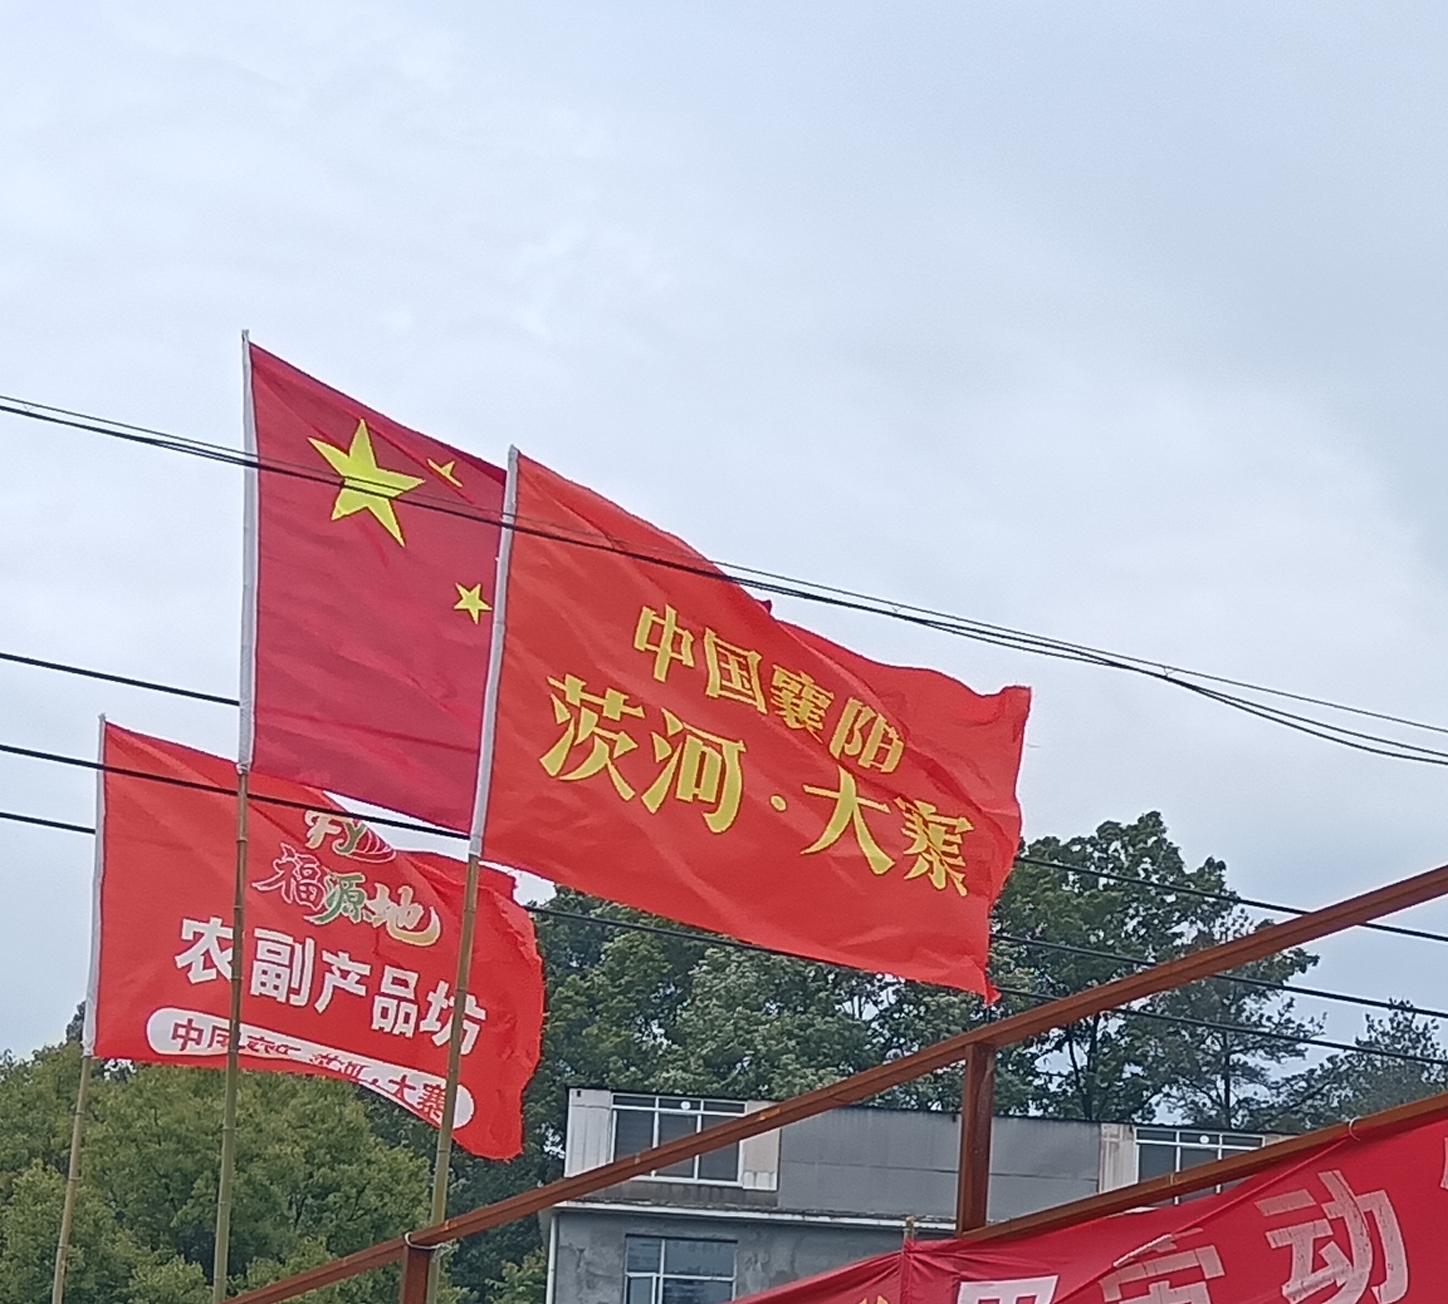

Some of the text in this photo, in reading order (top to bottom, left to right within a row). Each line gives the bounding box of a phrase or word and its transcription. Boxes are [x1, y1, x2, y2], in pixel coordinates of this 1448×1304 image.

[632, 603, 906, 774] 中国襄阳
[252, 842, 441, 947] 福源地
[175, 916, 488, 1055] 农副产品坊
